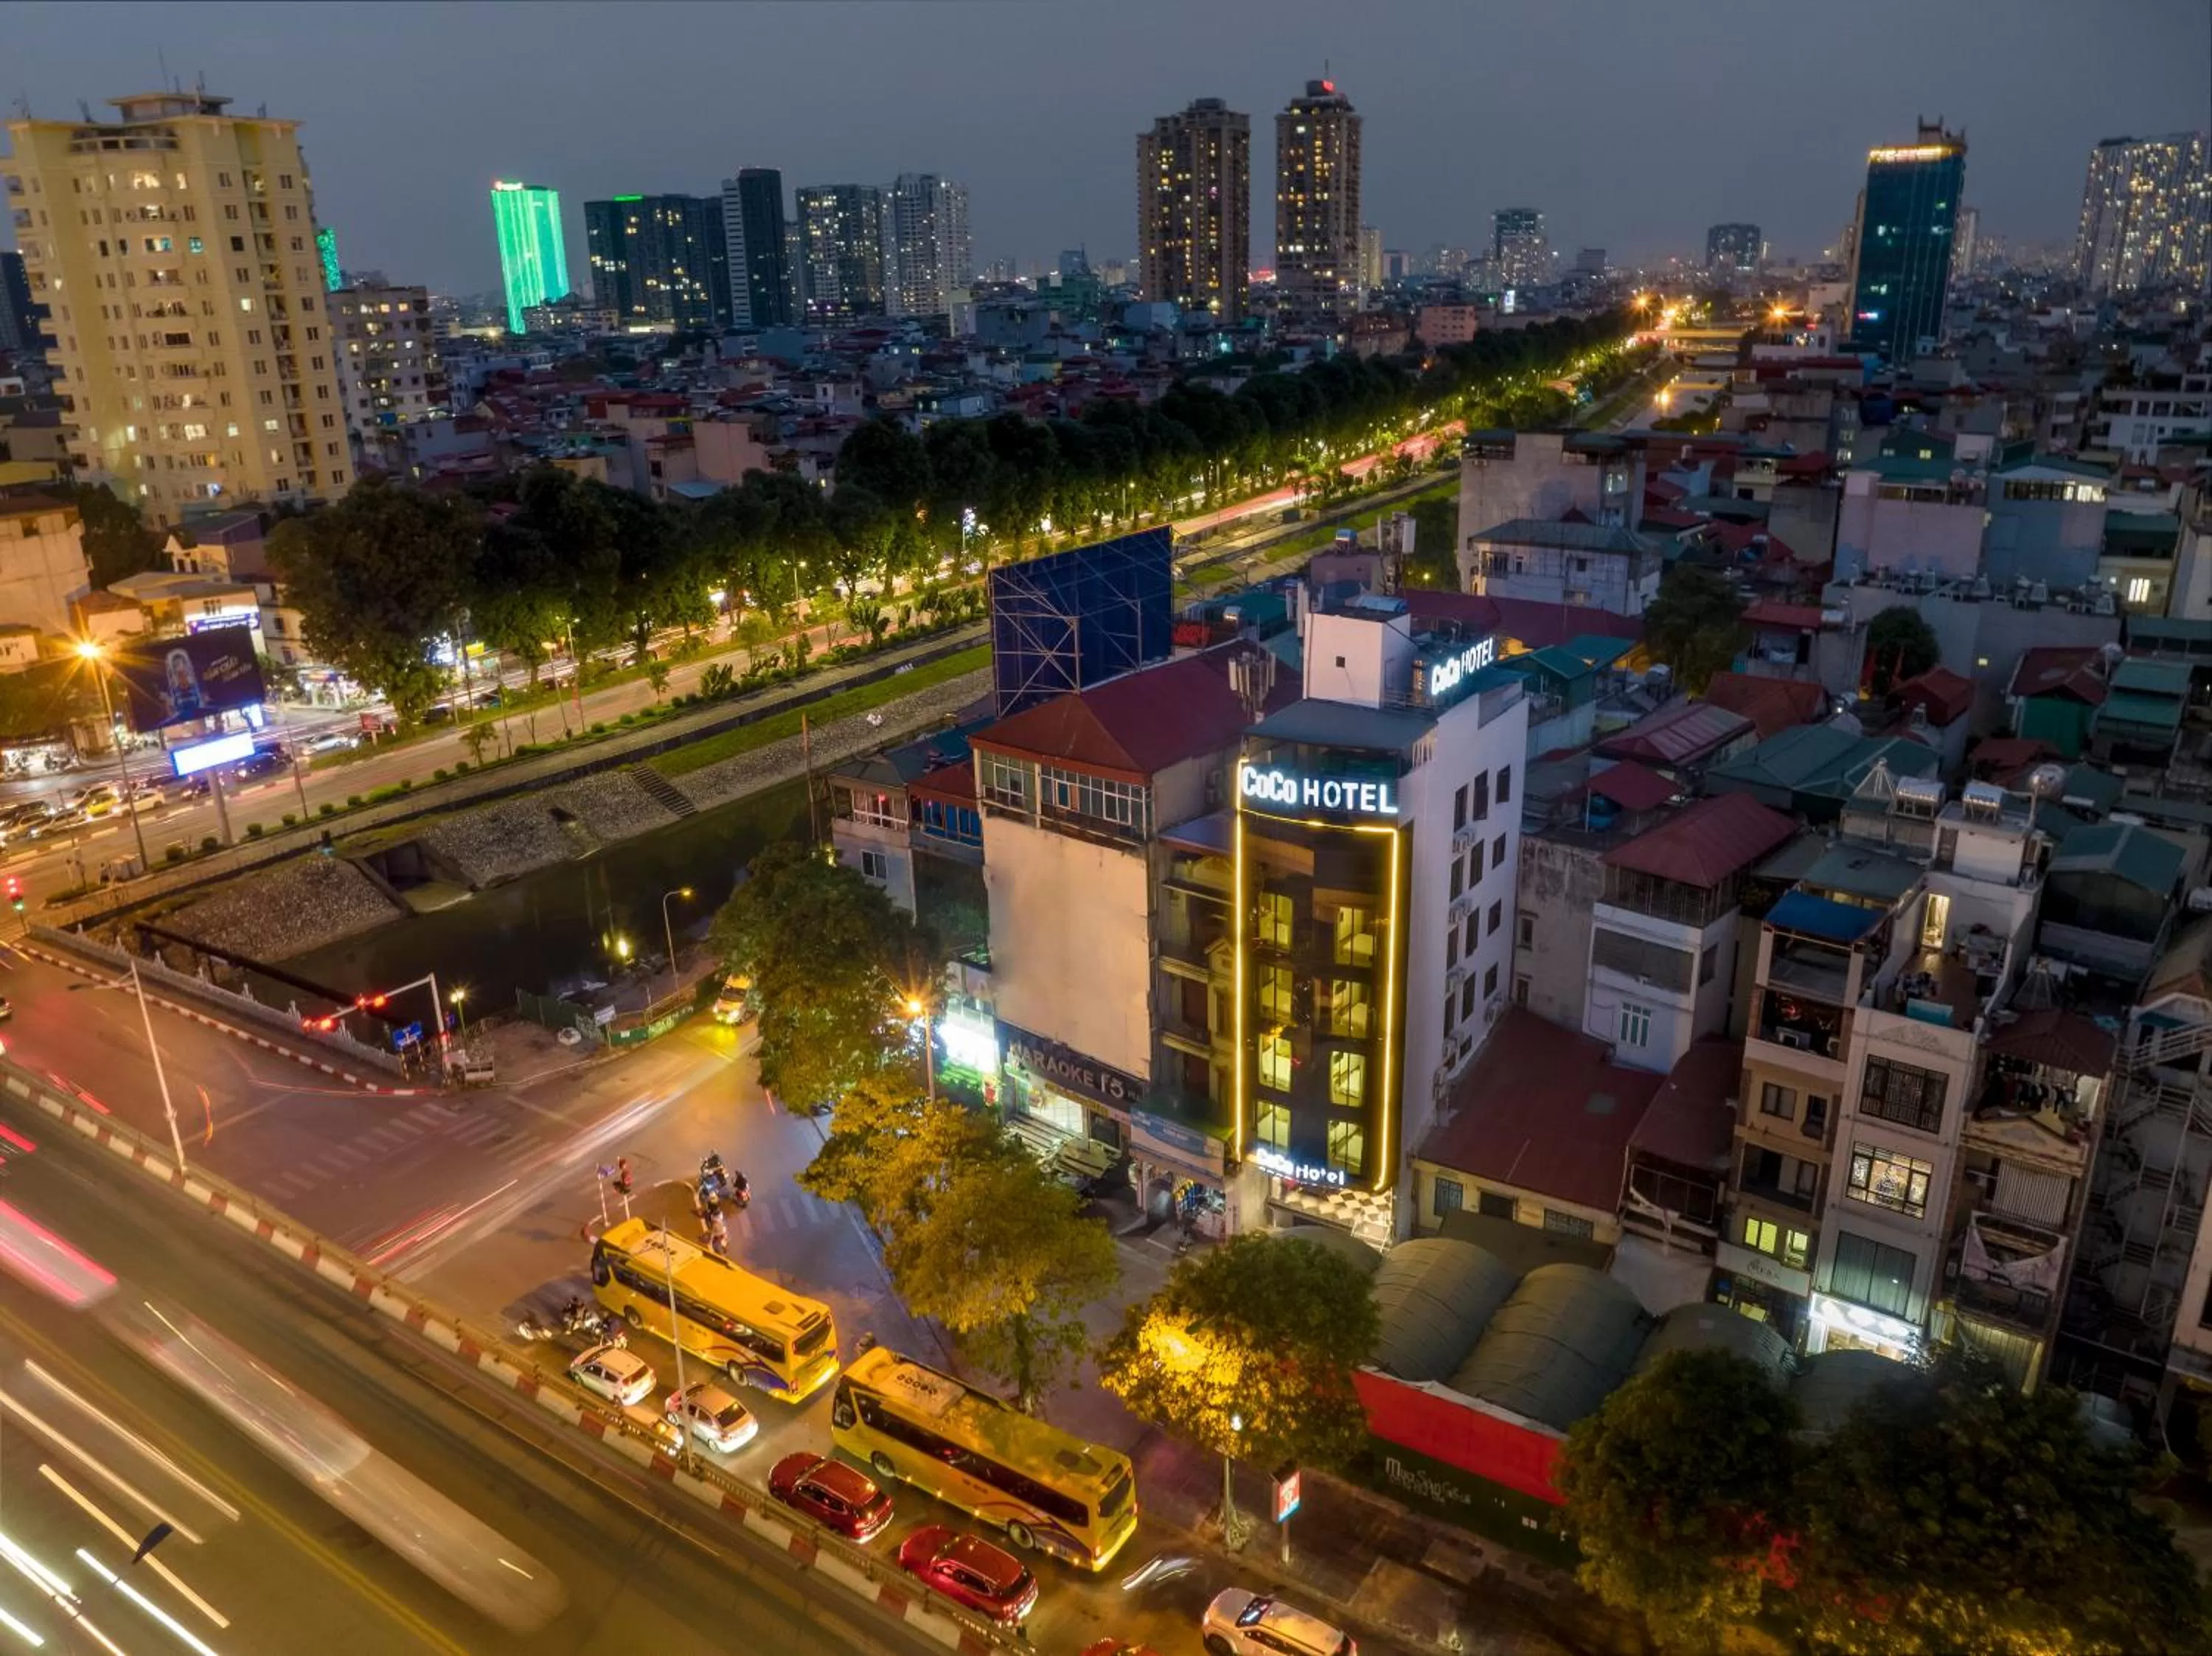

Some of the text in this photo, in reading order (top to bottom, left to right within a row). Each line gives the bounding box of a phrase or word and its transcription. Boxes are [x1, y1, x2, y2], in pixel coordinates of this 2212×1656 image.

[1461, 636, 1494, 678] HOTEL
[1242, 765, 1399, 814] CoCo HOTEL
